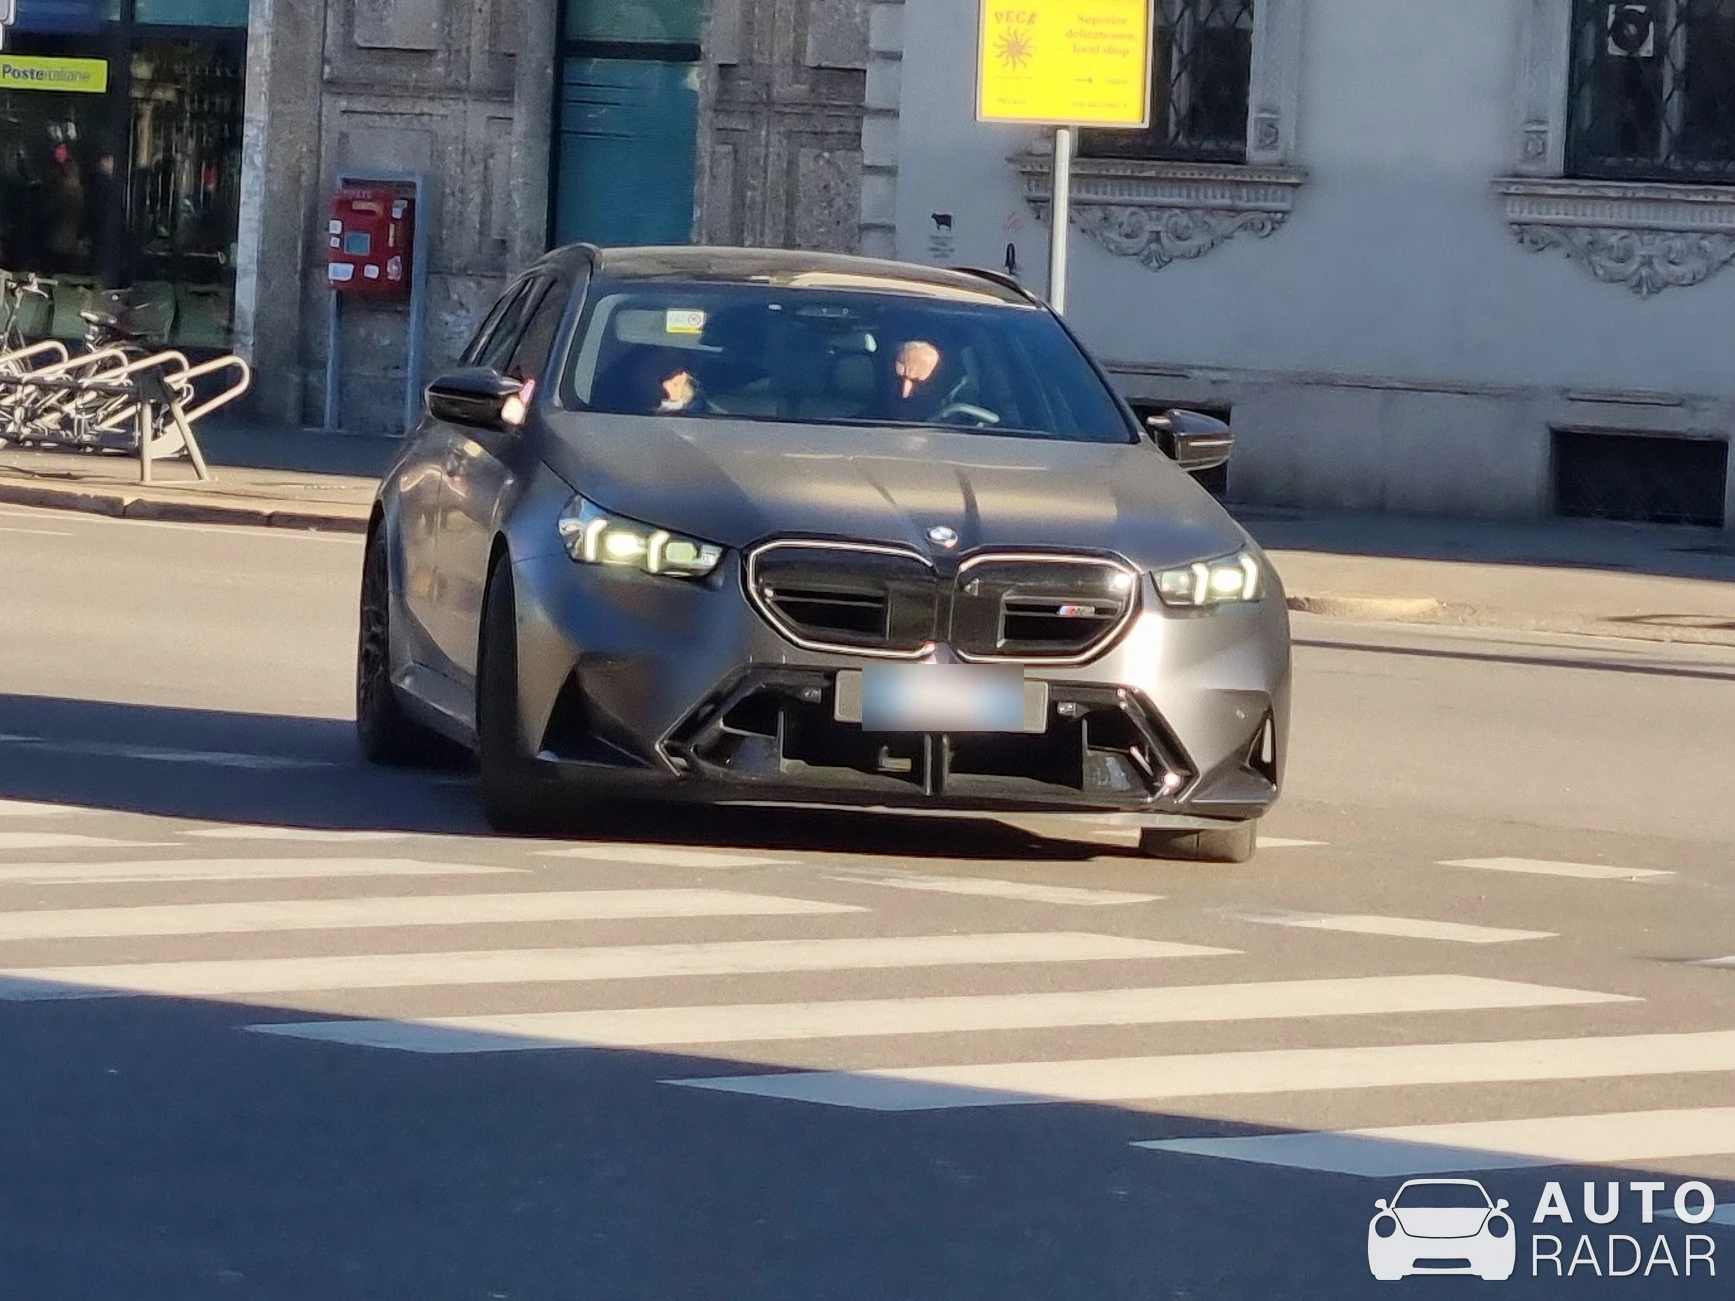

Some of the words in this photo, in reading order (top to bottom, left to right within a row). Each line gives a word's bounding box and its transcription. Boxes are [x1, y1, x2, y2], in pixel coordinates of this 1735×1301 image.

[994, 10, 1038, 25] PECK
[1077, 14, 1129, 26] Superior
[1072, 44, 1100, 54] local
